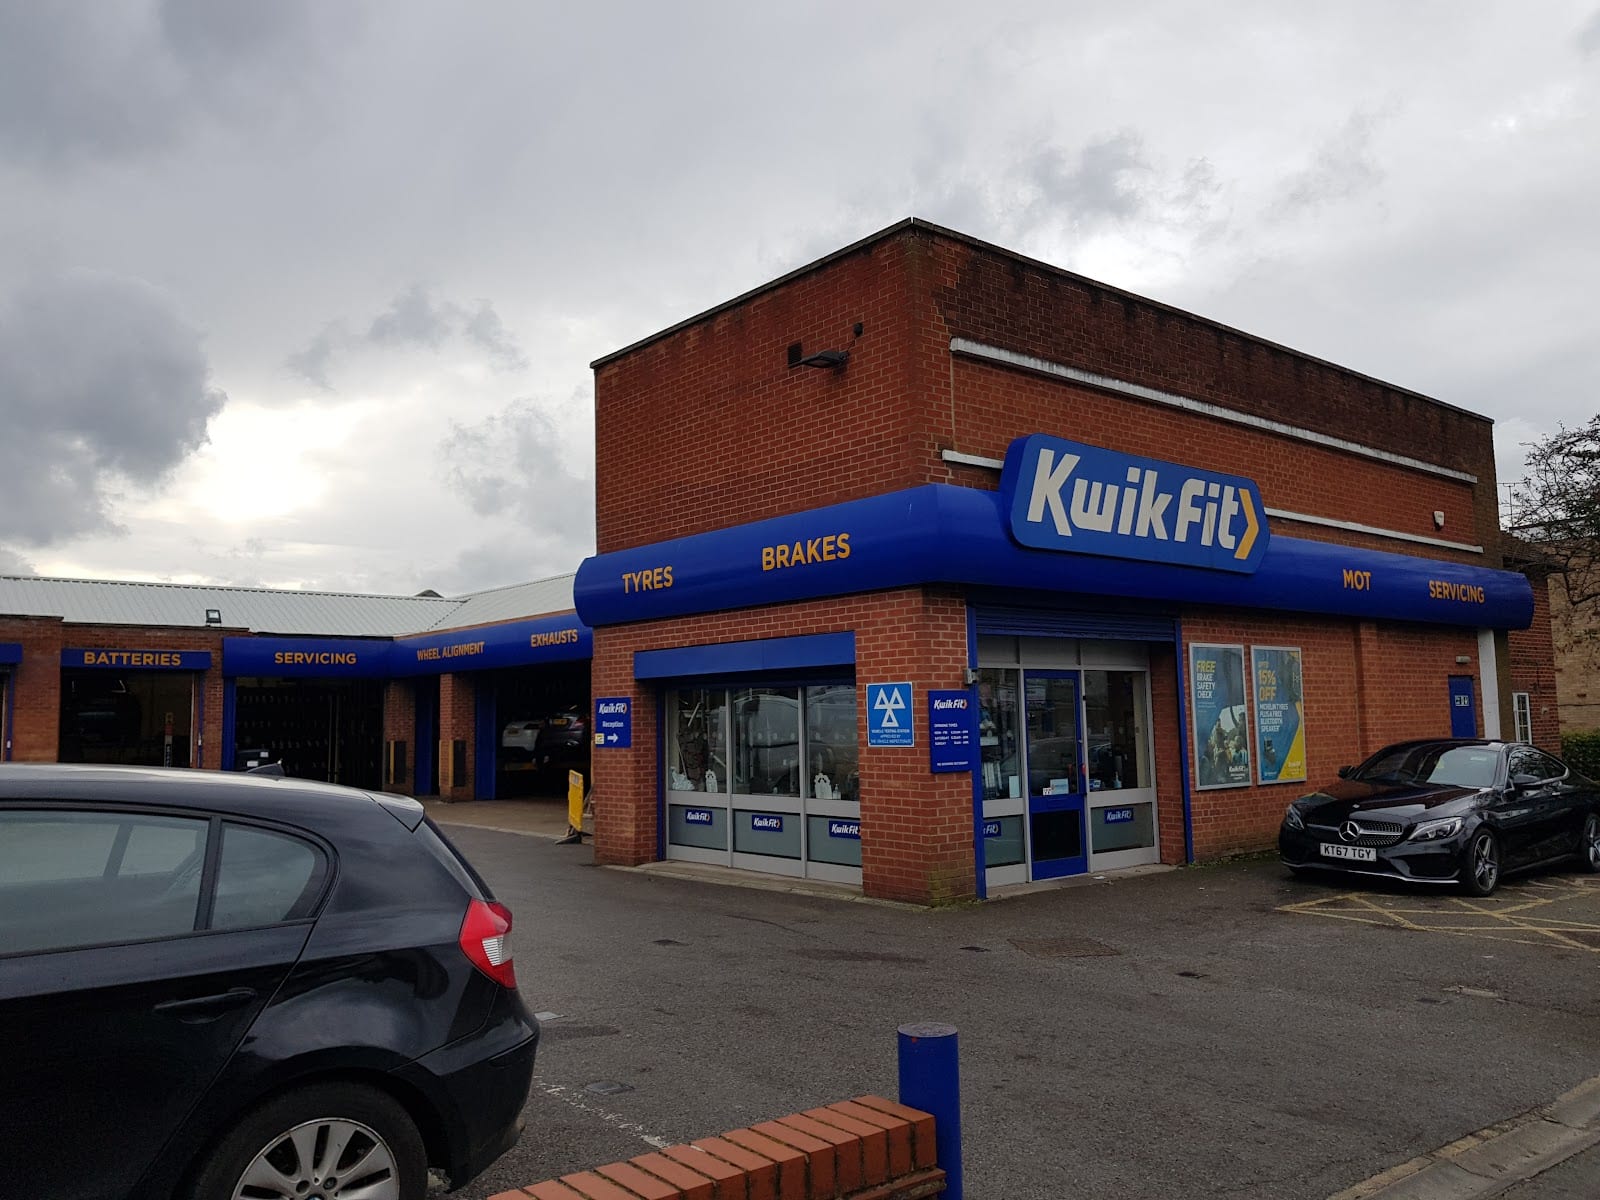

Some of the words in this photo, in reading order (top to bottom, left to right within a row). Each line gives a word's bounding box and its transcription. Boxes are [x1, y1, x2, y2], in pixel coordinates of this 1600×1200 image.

[1027, 448, 1173, 540] Kwik
[1174, 478, 1239, 550] Fit
[761, 533, 851, 571] BRAKES
[622, 566, 674, 594] TYRES
[1343, 568, 1371, 592] MOT
[1428, 579, 1485, 604] SERVICING
[530, 629, 578, 648] EXHAUSTS
[83, 651, 182, 668] BATTERIES
[274, 651, 357, 665] SERVICING
[416, 645, 440, 662] WHEEL
[441, 641, 485, 660] ALIGNMENT
[1197, 660, 1216, 673] FREE
[1197, 681, 1215, 690] SAFETY
[1258, 670, 1276, 685] 15%
[1259, 686, 1276, 701] OFF
[602, 720, 624, 728] Reception
[1324, 845, 1348, 857] KT67
[1351, 848, 1371, 859] TGY
